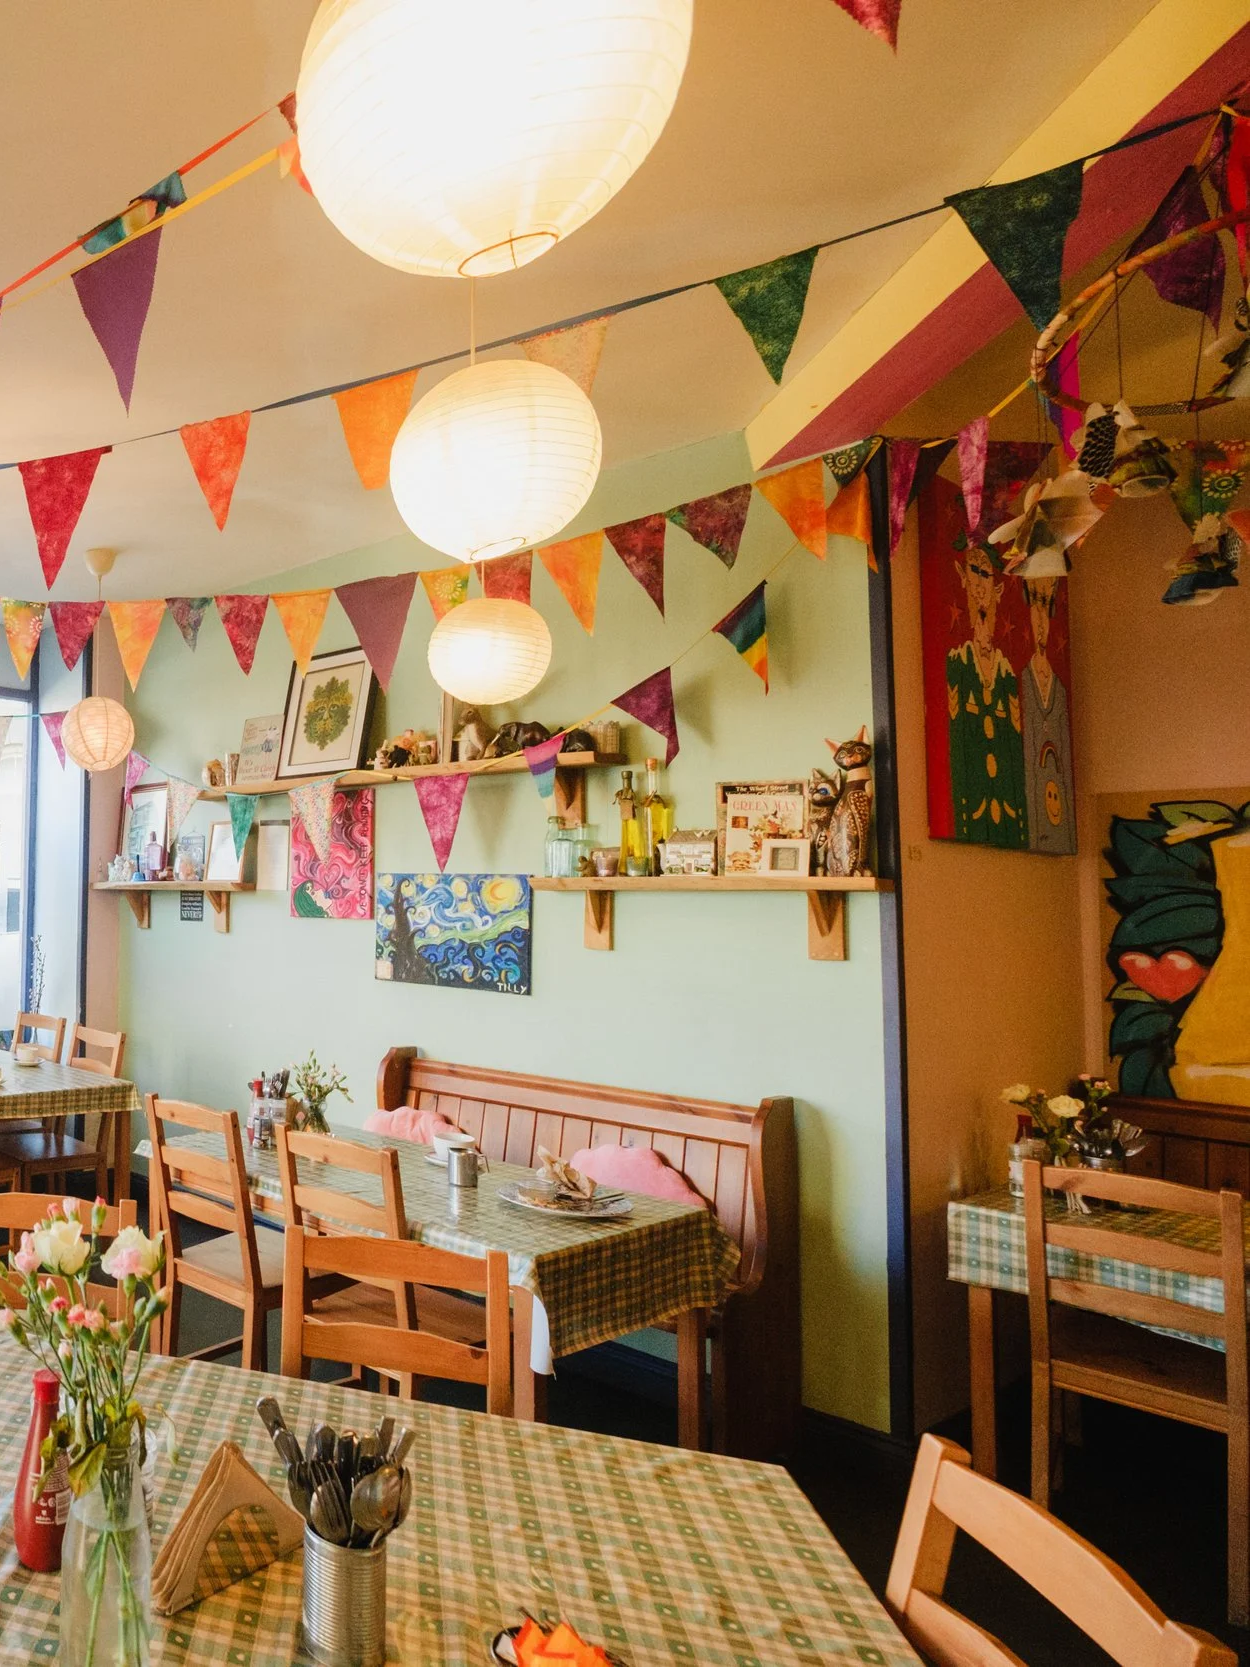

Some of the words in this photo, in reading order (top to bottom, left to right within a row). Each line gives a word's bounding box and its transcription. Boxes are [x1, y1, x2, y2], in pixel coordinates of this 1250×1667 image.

[732, 800, 768, 811] GREEN
[773, 800, 797, 811] MAN
[496, 982, 527, 994] TILLY
